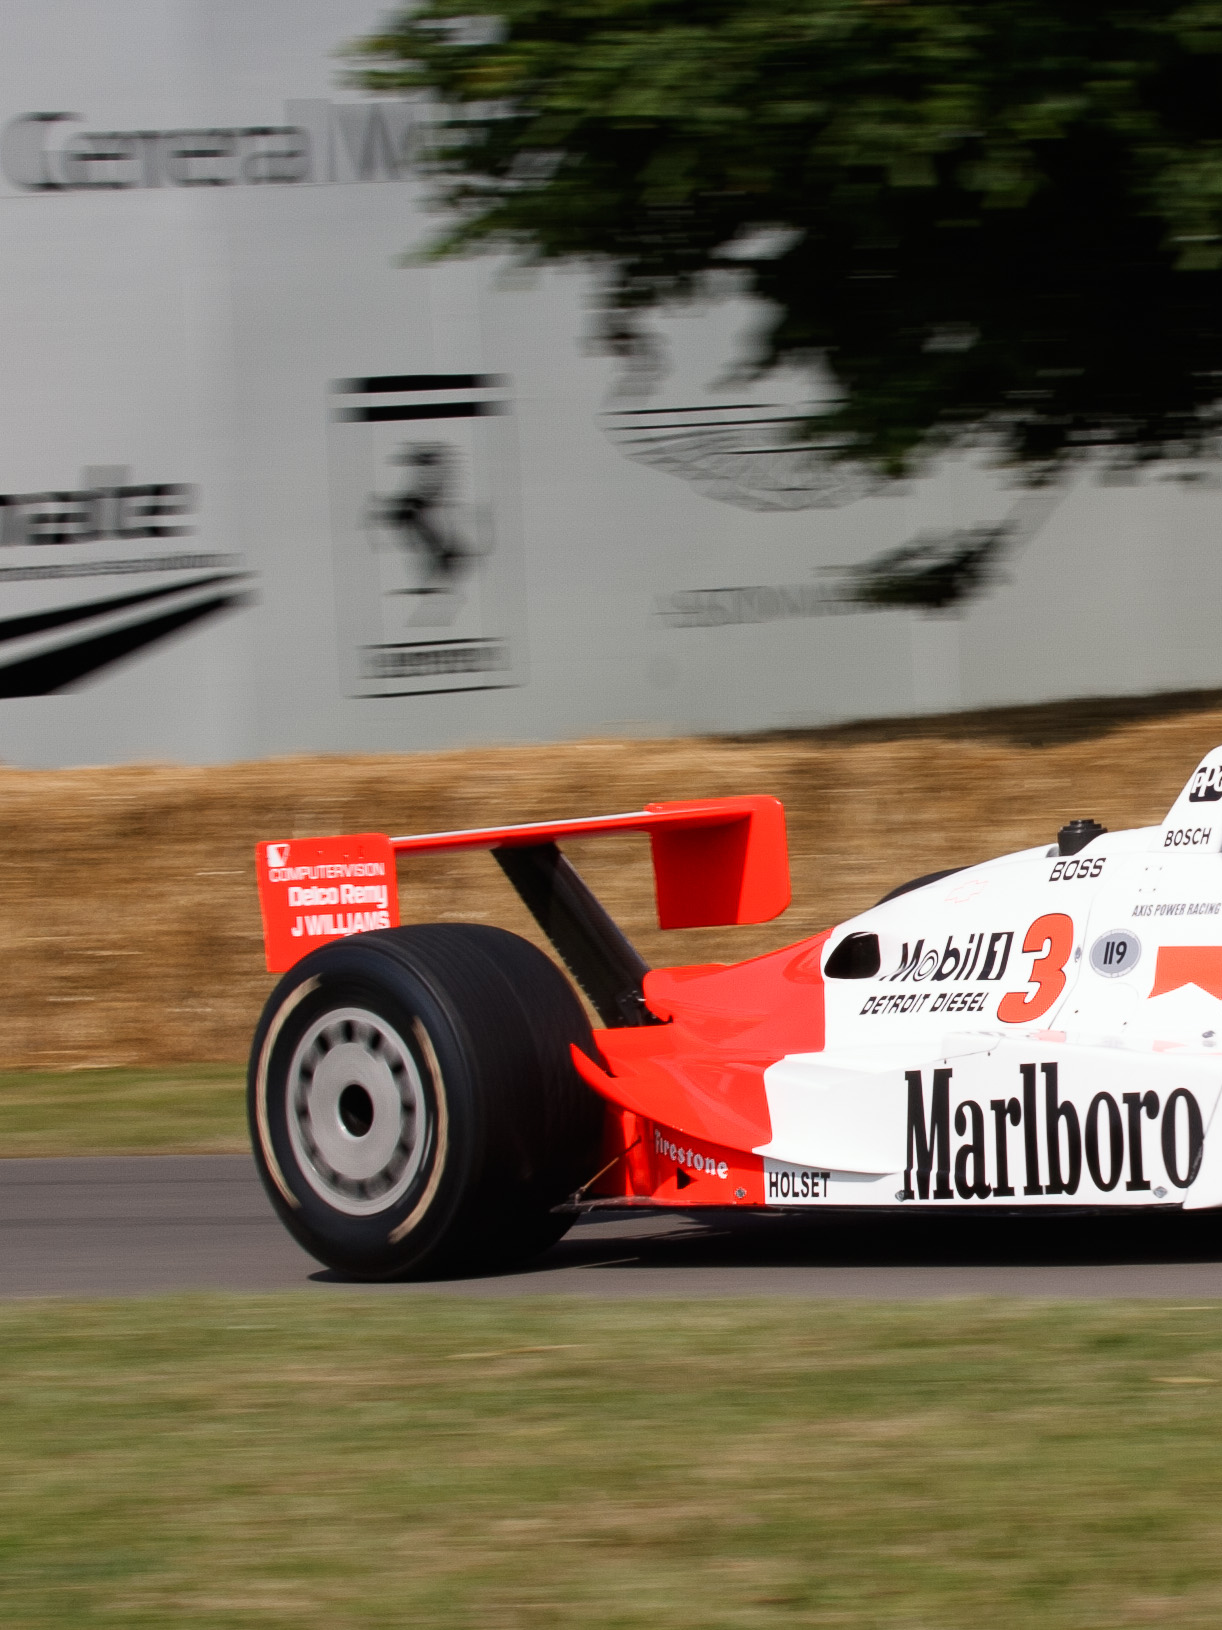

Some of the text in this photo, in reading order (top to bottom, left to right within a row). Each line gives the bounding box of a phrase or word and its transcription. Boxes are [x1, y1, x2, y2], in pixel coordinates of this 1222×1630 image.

[1164, 827, 1212, 847] BOSCH
[268, 862, 385, 883] COMPUTERVISION
[1048, 857, 1107, 882] BOSS
[287, 884, 388, 909] Delco Remy
[1131, 902, 1222, 917] AXIS POWER RACING
[291, 910, 391, 937] J WILLIAMS
[1103, 940, 1128, 965] 119
[997, 913, 1074, 1023] 3
[859, 991, 990, 1015] DETROIT DIESEL
[903, 1061, 1205, 1200] Marlboro
[655, 1129, 729, 1180] Firestone
[769, 1171, 831, 1198] HOLSET
